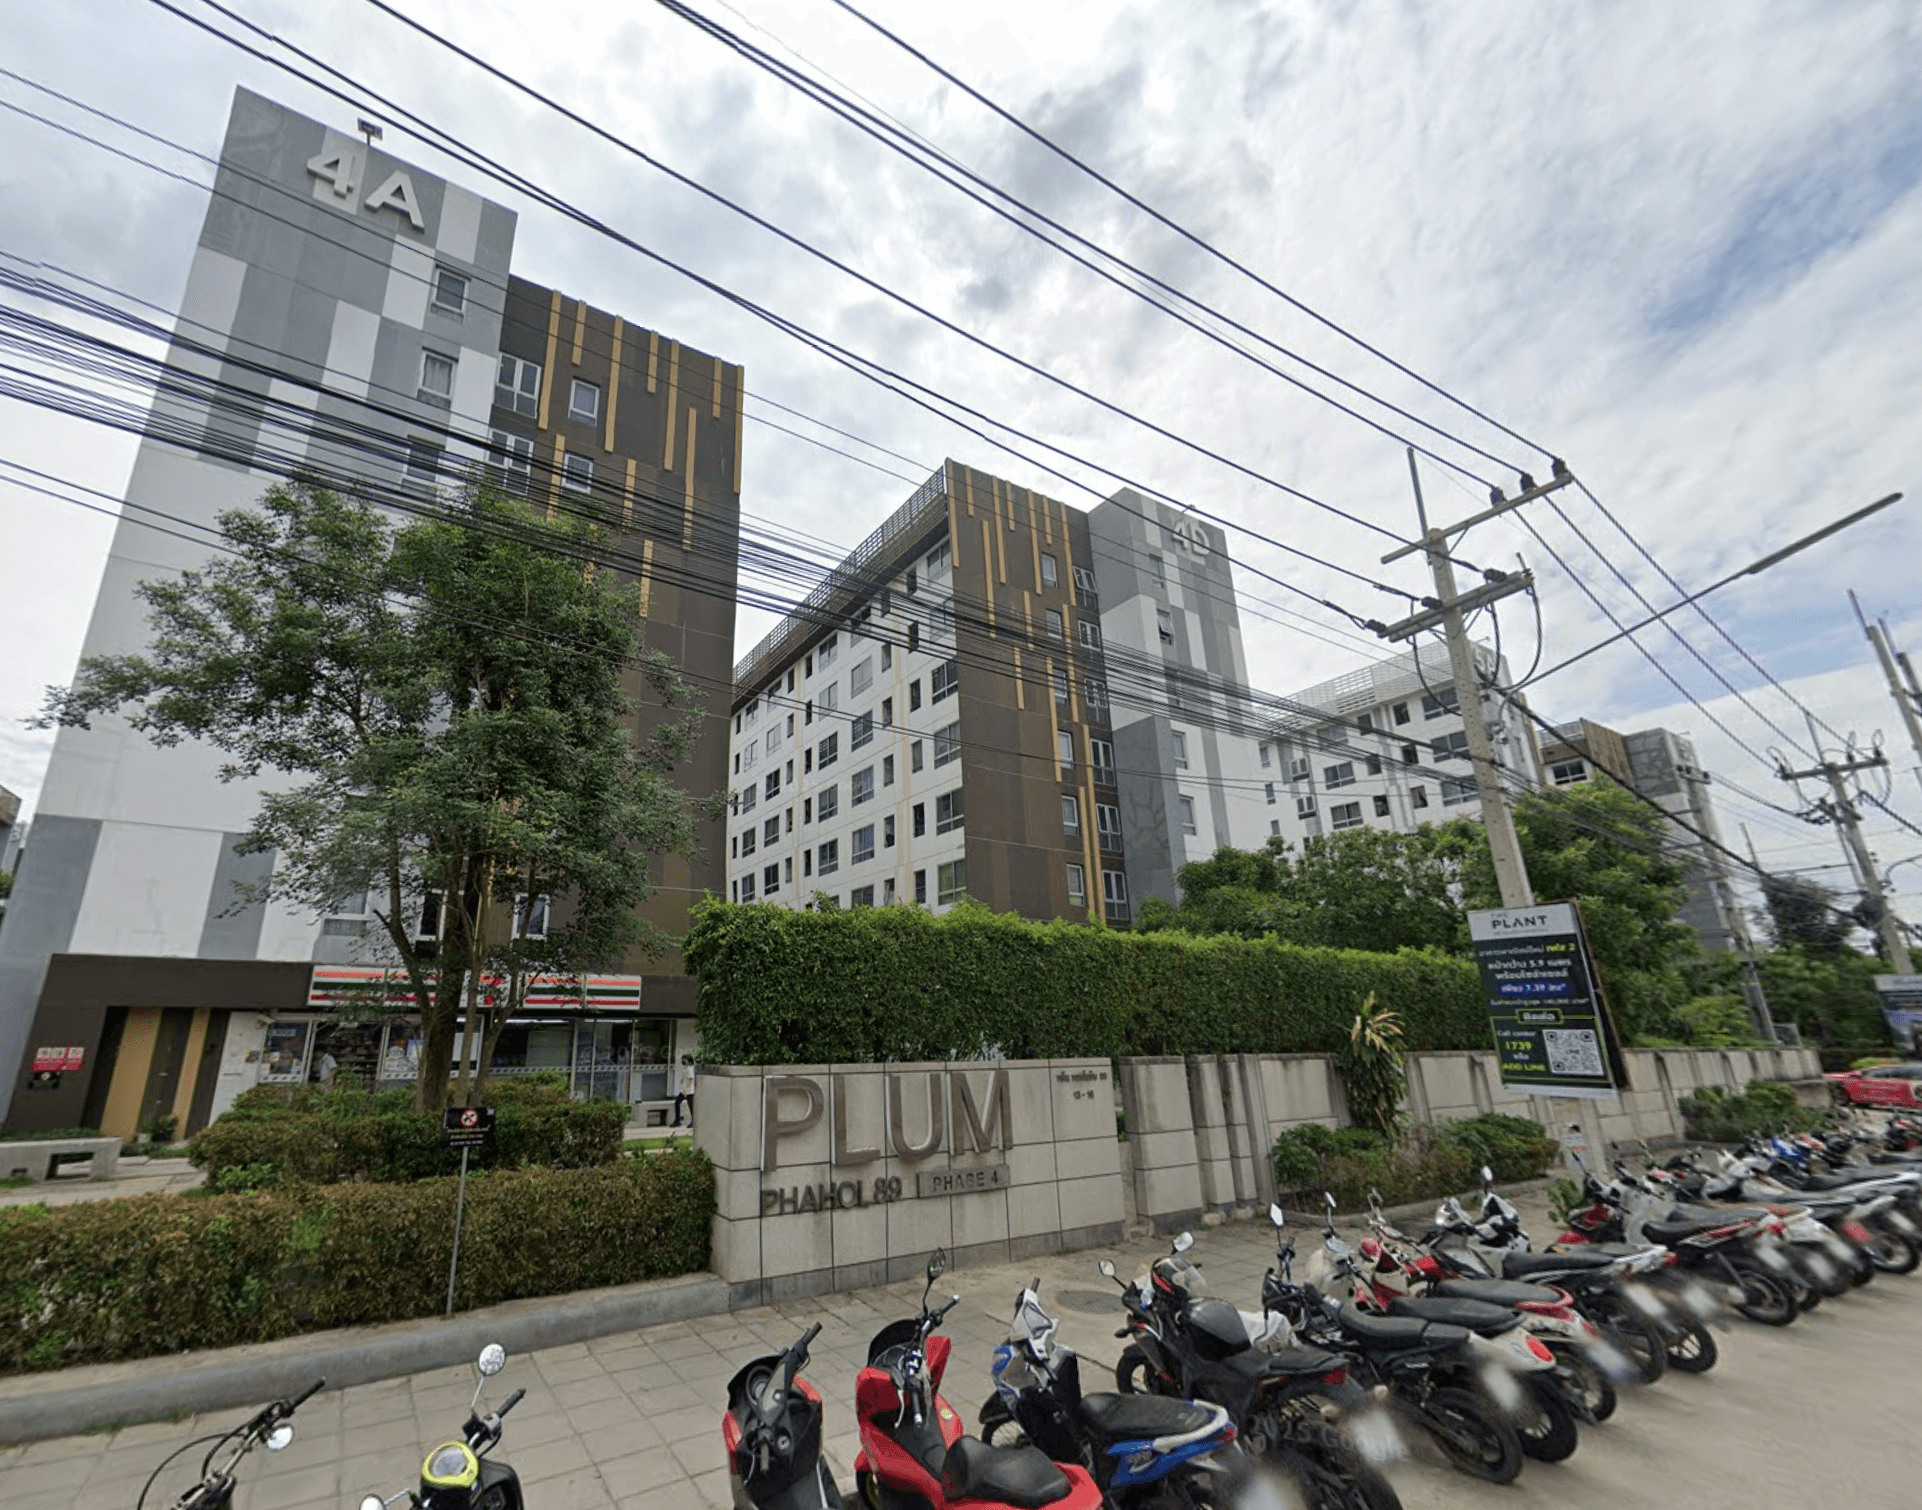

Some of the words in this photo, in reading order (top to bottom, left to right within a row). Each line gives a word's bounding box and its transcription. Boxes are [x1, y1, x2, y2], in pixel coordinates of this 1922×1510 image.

[306, 153, 425, 234] 4A
[1171, 522, 1210, 556] 4D
[1491, 914, 1548, 930] PLANT
[761, 1070, 1013, 1172] PLUM
[761, 1180, 869, 1216] PHAHOL
[874, 1176, 901, 1203] 89
[932, 1172, 985, 1192] PHASE
[988, 1170, 999, 1185] 4
